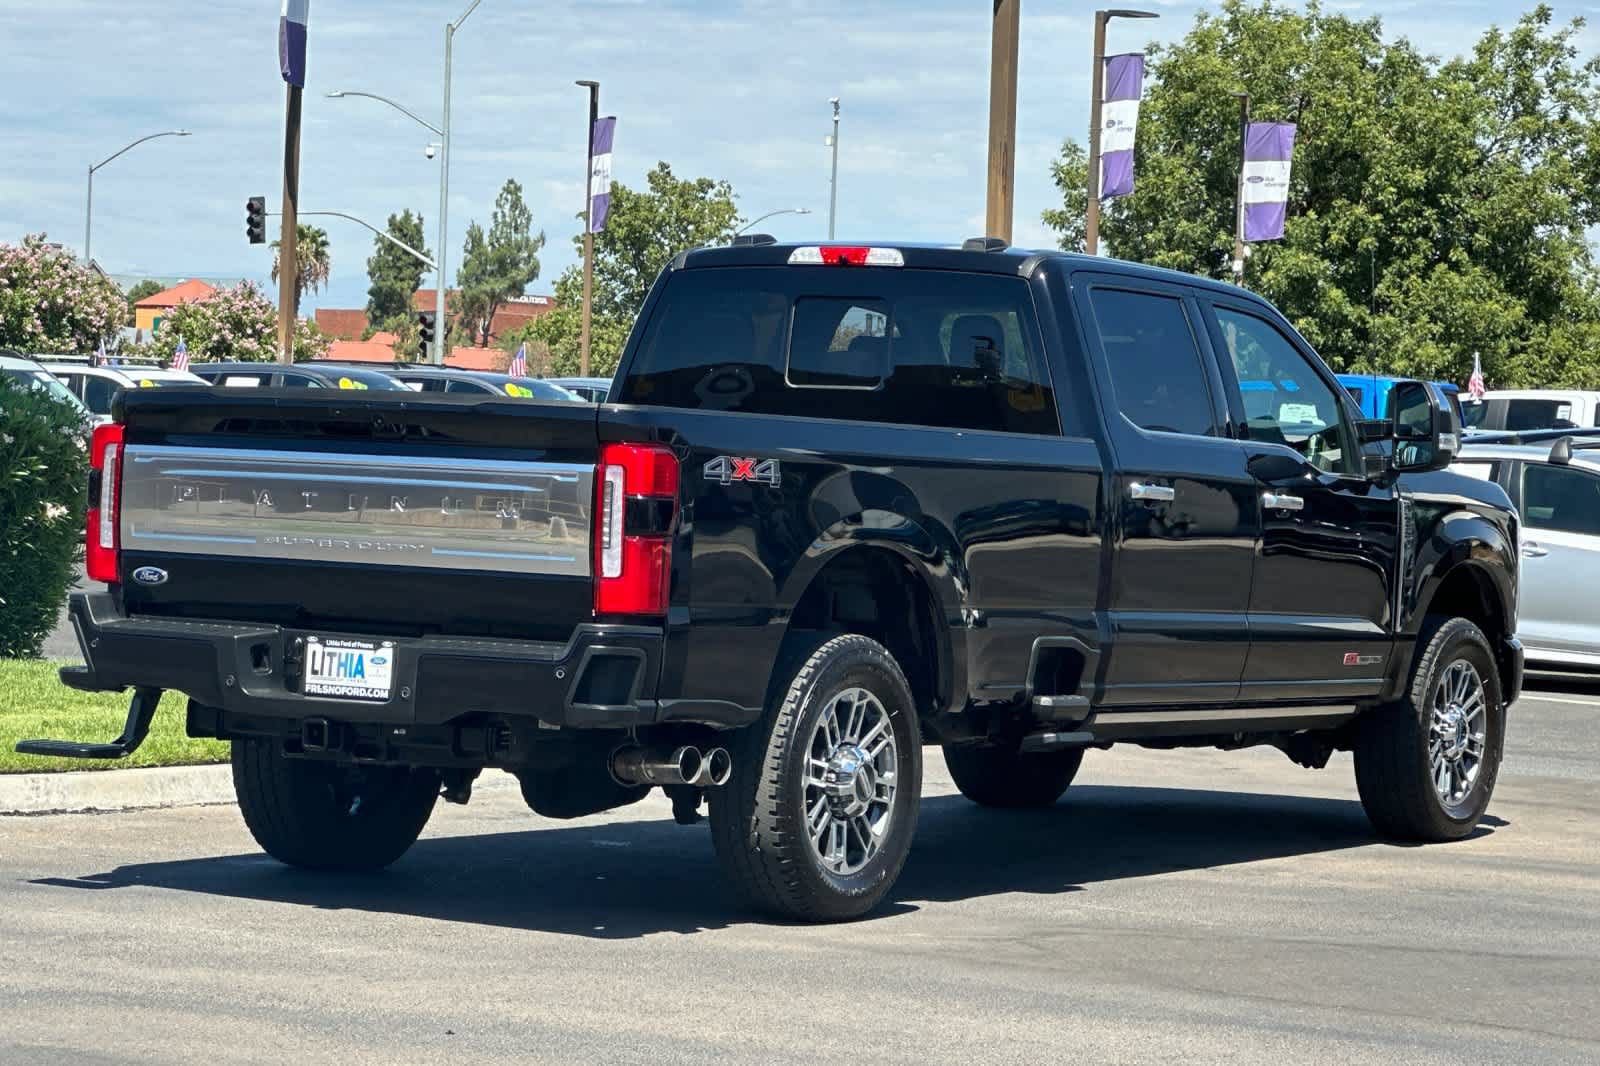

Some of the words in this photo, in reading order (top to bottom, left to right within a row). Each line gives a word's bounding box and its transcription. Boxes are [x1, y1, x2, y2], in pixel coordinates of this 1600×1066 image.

[174, 485, 519, 518] PLATINUM
[311, 650, 365, 679] LITHIA
[305, 684, 389, 698] FRESNOFORD.COM
